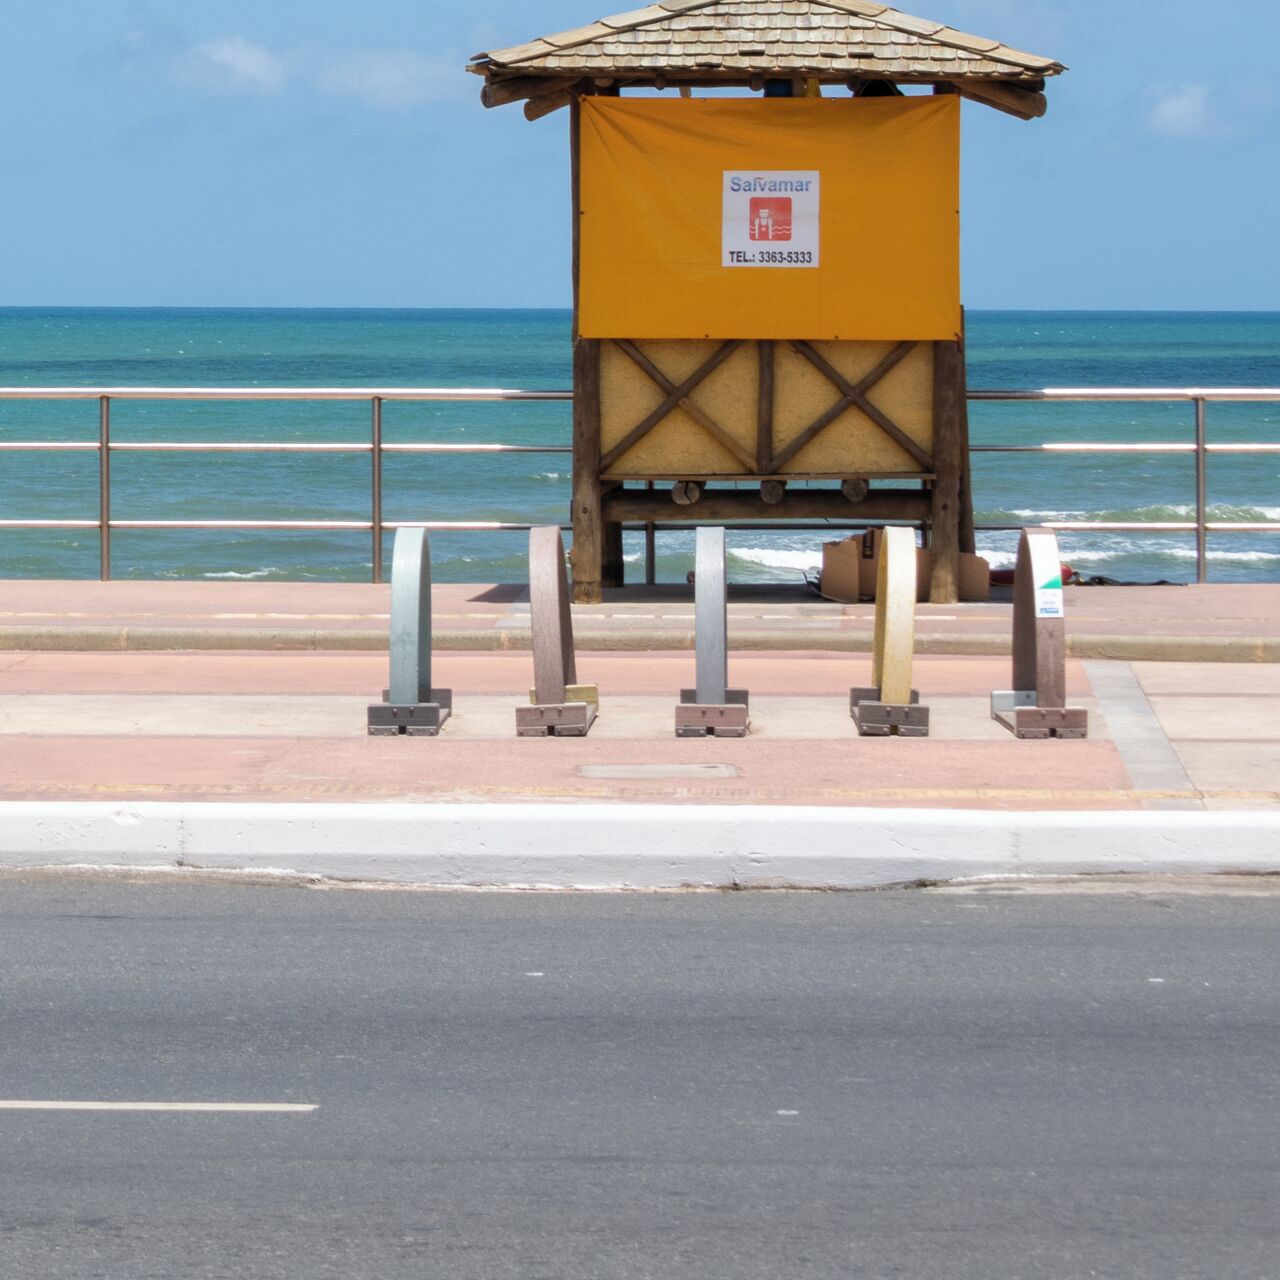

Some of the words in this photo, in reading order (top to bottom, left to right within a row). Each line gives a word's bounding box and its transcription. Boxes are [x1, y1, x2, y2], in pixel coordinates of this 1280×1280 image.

[730, 176, 812, 192] Salvamar
[729, 251, 755, 263] TEL.:
[758, 251, 812, 263] 3363-5333
